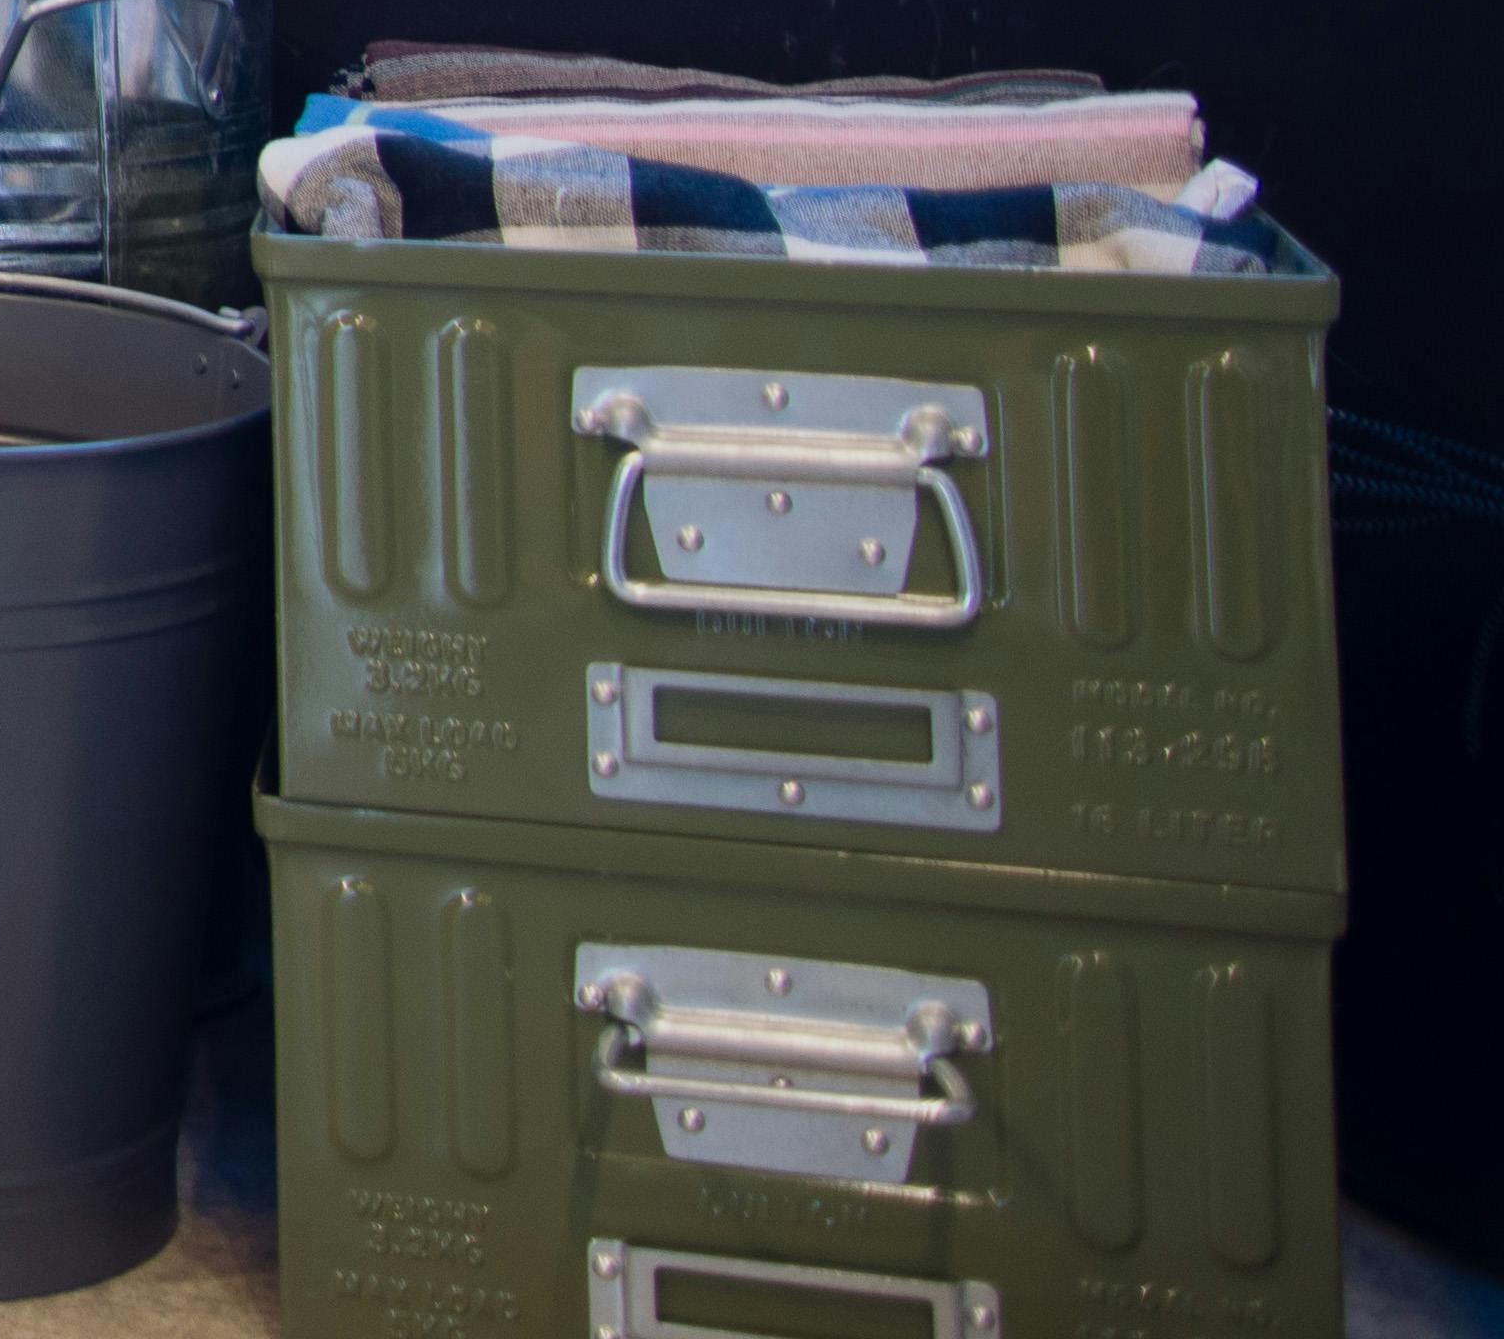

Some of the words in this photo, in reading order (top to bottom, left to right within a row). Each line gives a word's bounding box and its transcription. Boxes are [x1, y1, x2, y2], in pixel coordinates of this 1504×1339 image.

[348, 626, 488, 664] WEIGHT
[1071, 678, 1201, 711] MODEL
[330, 709, 409, 743] MAX
[419, 714, 521, 752] LOAD
[1137, 806, 1281, 845] LITER
[347, 1187, 491, 1228] WEIGHT
[333, 1268, 410, 1304] MAX
[420, 1280, 520, 1320] LOAD
